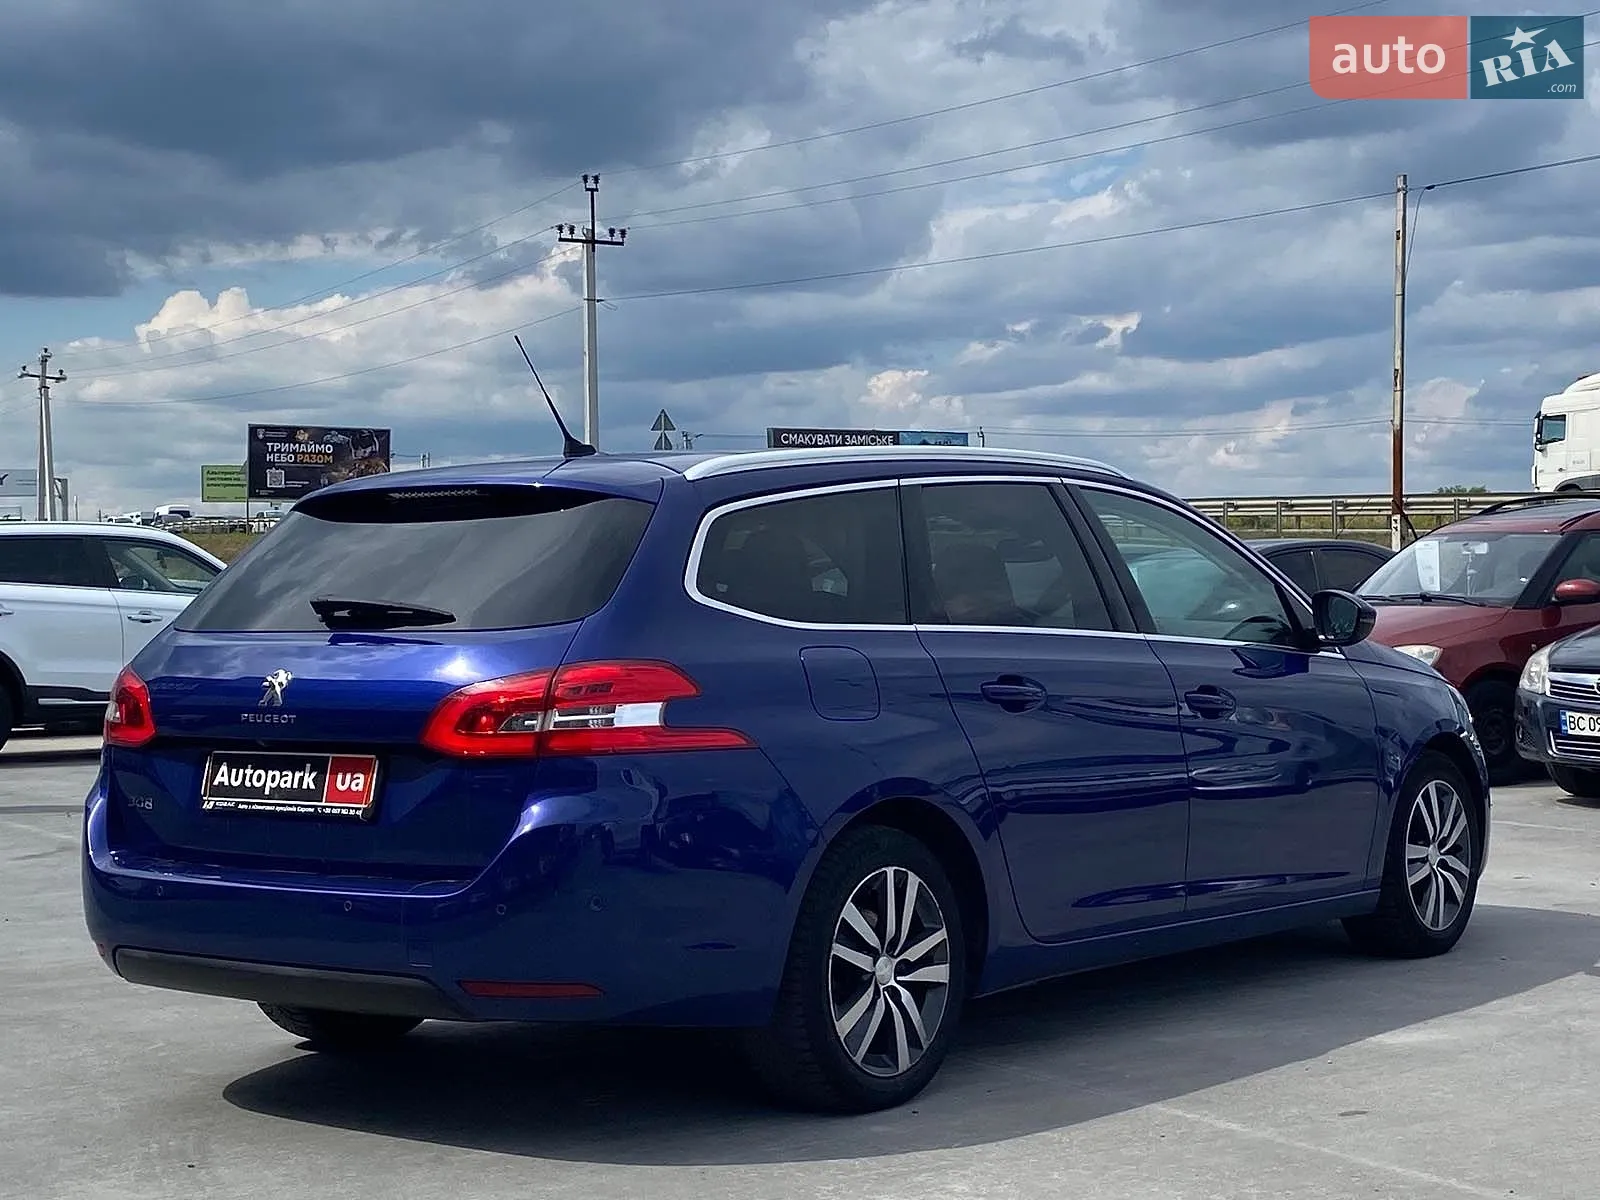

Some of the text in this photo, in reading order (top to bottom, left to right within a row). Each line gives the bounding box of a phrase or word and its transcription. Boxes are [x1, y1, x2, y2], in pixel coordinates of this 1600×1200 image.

[780, 433, 894, 446] СМАКУВАТИ ЗАМІСЬКЕ
[266, 441, 333, 453] ТРИМАЙМО
[266, 453, 333, 463] НЕБО РАЗОМ
[240, 713, 297, 724] PEUGEOT
[1568, 715, 1586, 731] BC
[213, 762, 365, 795] Autopark ua
